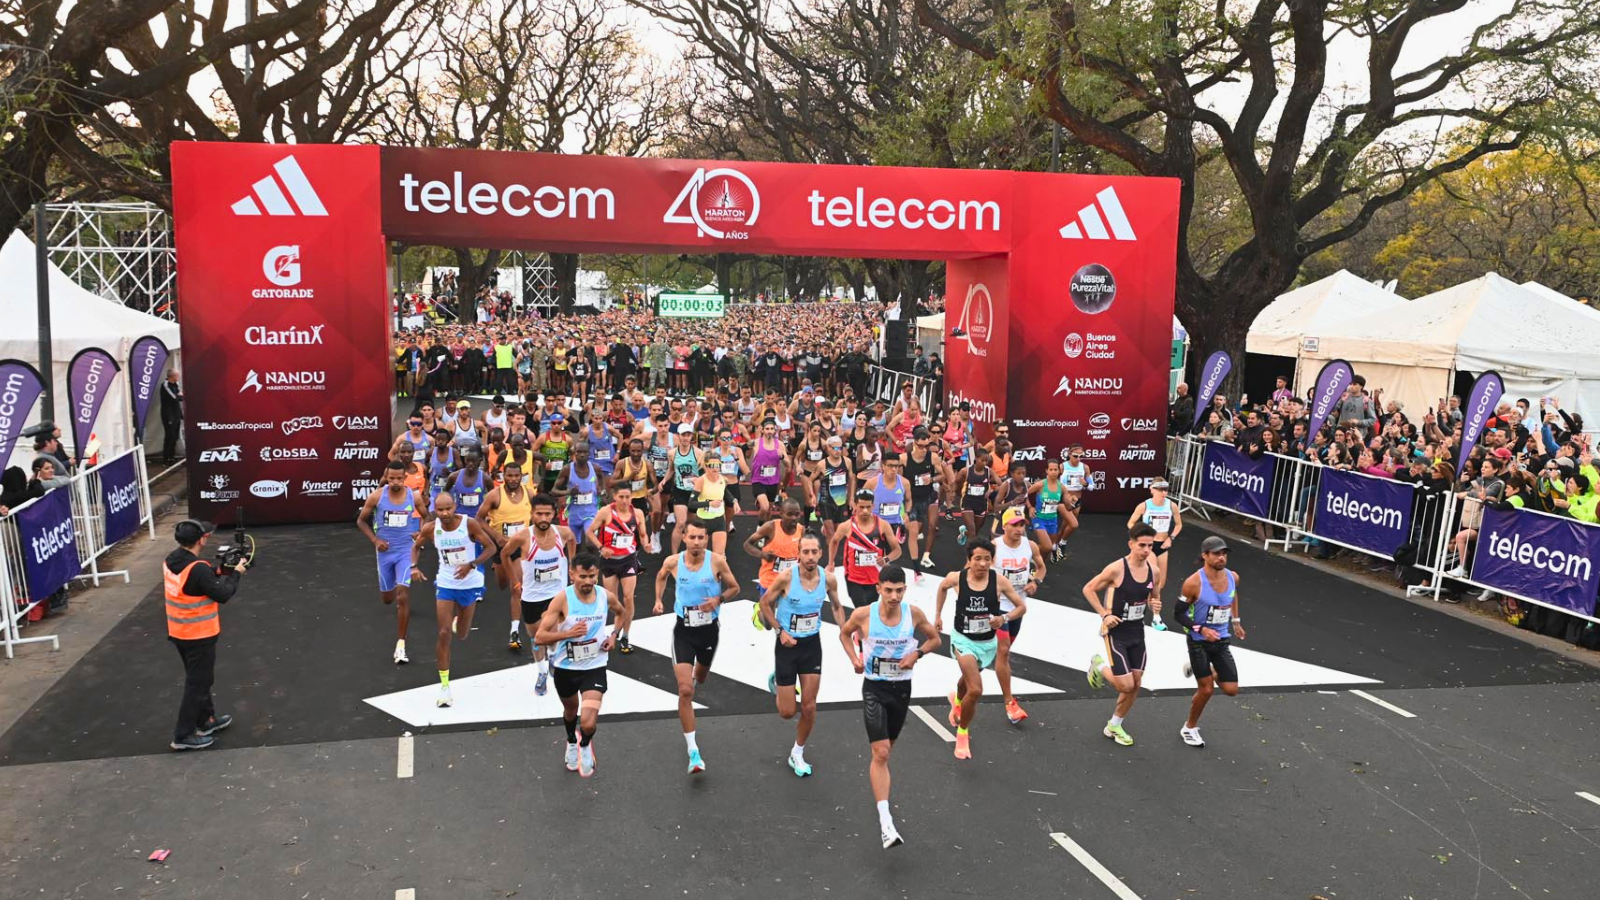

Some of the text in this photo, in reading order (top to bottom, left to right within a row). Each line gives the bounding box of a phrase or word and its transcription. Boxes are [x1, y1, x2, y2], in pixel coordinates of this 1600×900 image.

[400, 171, 616, 220] telecom
[704, 208, 746, 218] MARATON
[807, 186, 1001, 232] telecom
[725, 229, 749, 240] AÑOS
[1080, 275, 1105, 283] Nestlé
[251, 288, 314, 299] GATORADE
[661, 299, 723, 311] 00:00:03
[244, 325, 312, 345] Clarín
[1086, 333, 1116, 341] Buenos
[1086, 342, 1109, 350] Aires
[1086, 350, 1115, 359] Ciudad
[138, 345, 158, 400] telecom
[1200, 356, 1226, 401] telecom
[78, 358, 104, 425] telecom
[1314, 367, 1346, 421] telecom
[1464, 380, 1496, 444] telecom
[211, 421, 274, 432] BananaTropical
[347, 416, 379, 426] IAM
[1025, 419, 1079, 429] BananaTropical
[1133, 418, 1158, 428] IAM
[199, 449, 240, 463] ENA
[272, 448, 319, 458] ObSBA
[334, 447, 379, 460] RAPTOR
[1012, 450, 1045, 461] ENA
[1118, 449, 1156, 461] RAPTOR
[351, 479, 379, 487] CEREAL
[1208, 461, 1265, 494] telecom
[302, 480, 343, 492] Kynetar
[1326, 489, 1403, 531] telecom
[1488, 530, 1592, 581] telecom
[1002, 558, 1030, 568] FILA
[697, 611, 704, 620] 12
[805, 619, 812, 627] 15
[875, 638, 908, 646] ARGENTINA
[889, 663, 897, 672] 14
